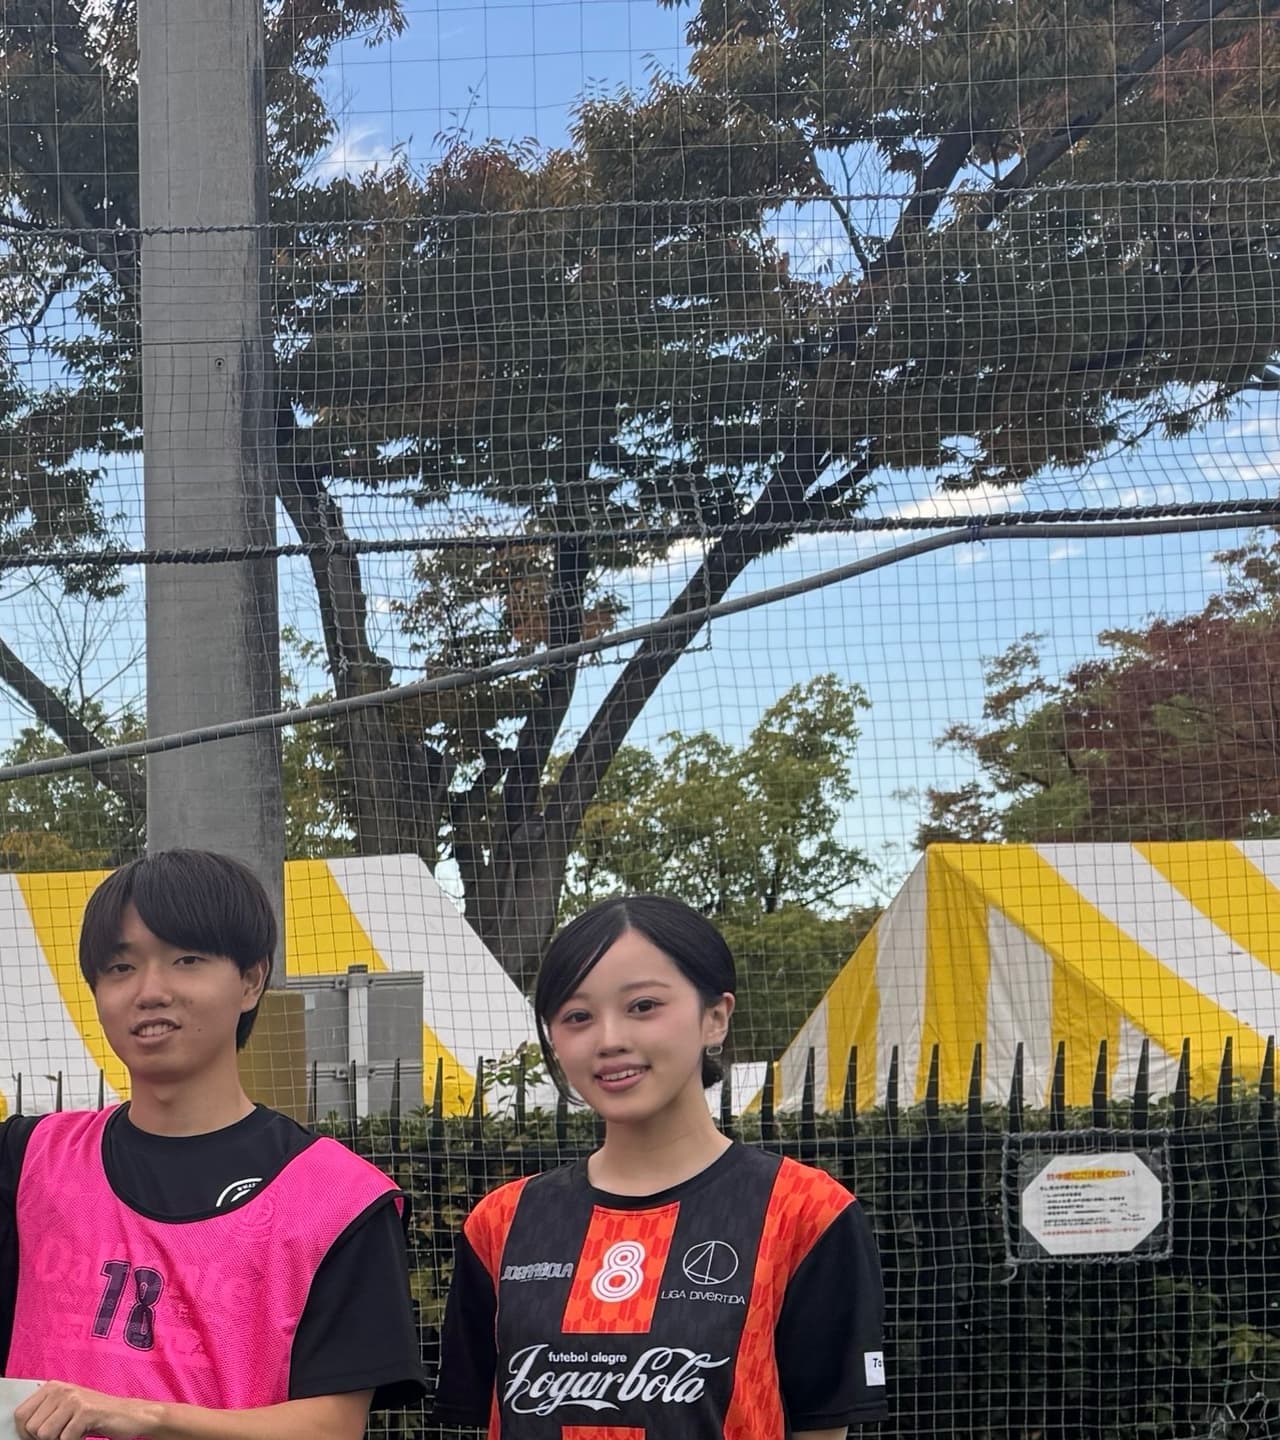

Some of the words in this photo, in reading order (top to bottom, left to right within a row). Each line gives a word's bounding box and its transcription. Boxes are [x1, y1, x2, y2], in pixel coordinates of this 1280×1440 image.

[591, 1241, 645, 1302] 8
[92, 1259, 163, 1351] 18
[503, 1344, 730, 1416] Jogarbola
[548, 1351, 588, 1363] futebol
